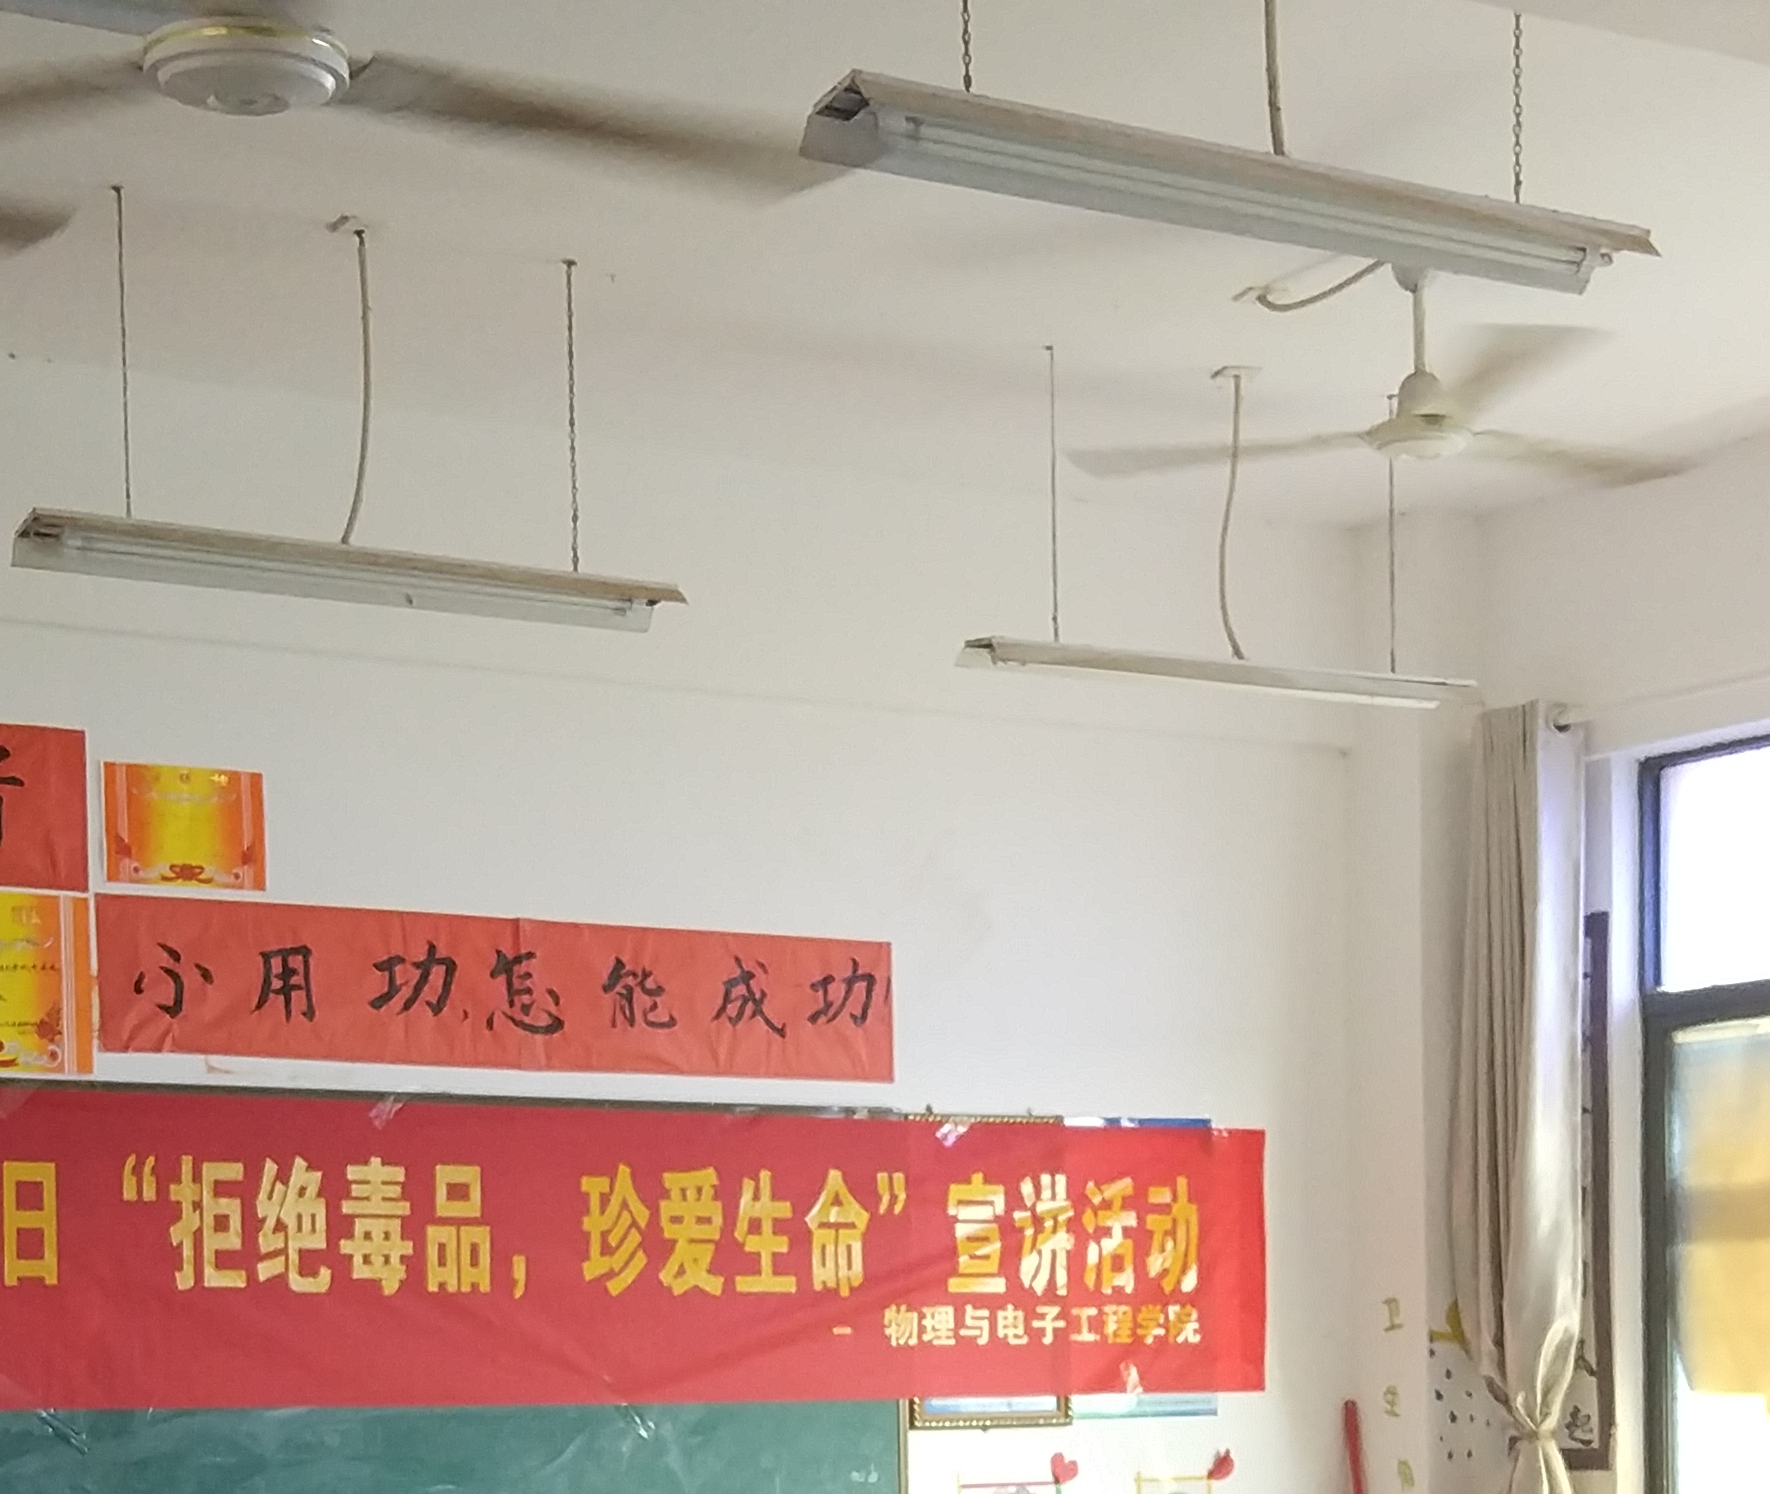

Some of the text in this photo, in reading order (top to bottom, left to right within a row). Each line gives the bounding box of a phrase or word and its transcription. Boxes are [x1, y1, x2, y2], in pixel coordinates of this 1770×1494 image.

[883, 1302, 1202, 1347] 物理与电子工程学院
